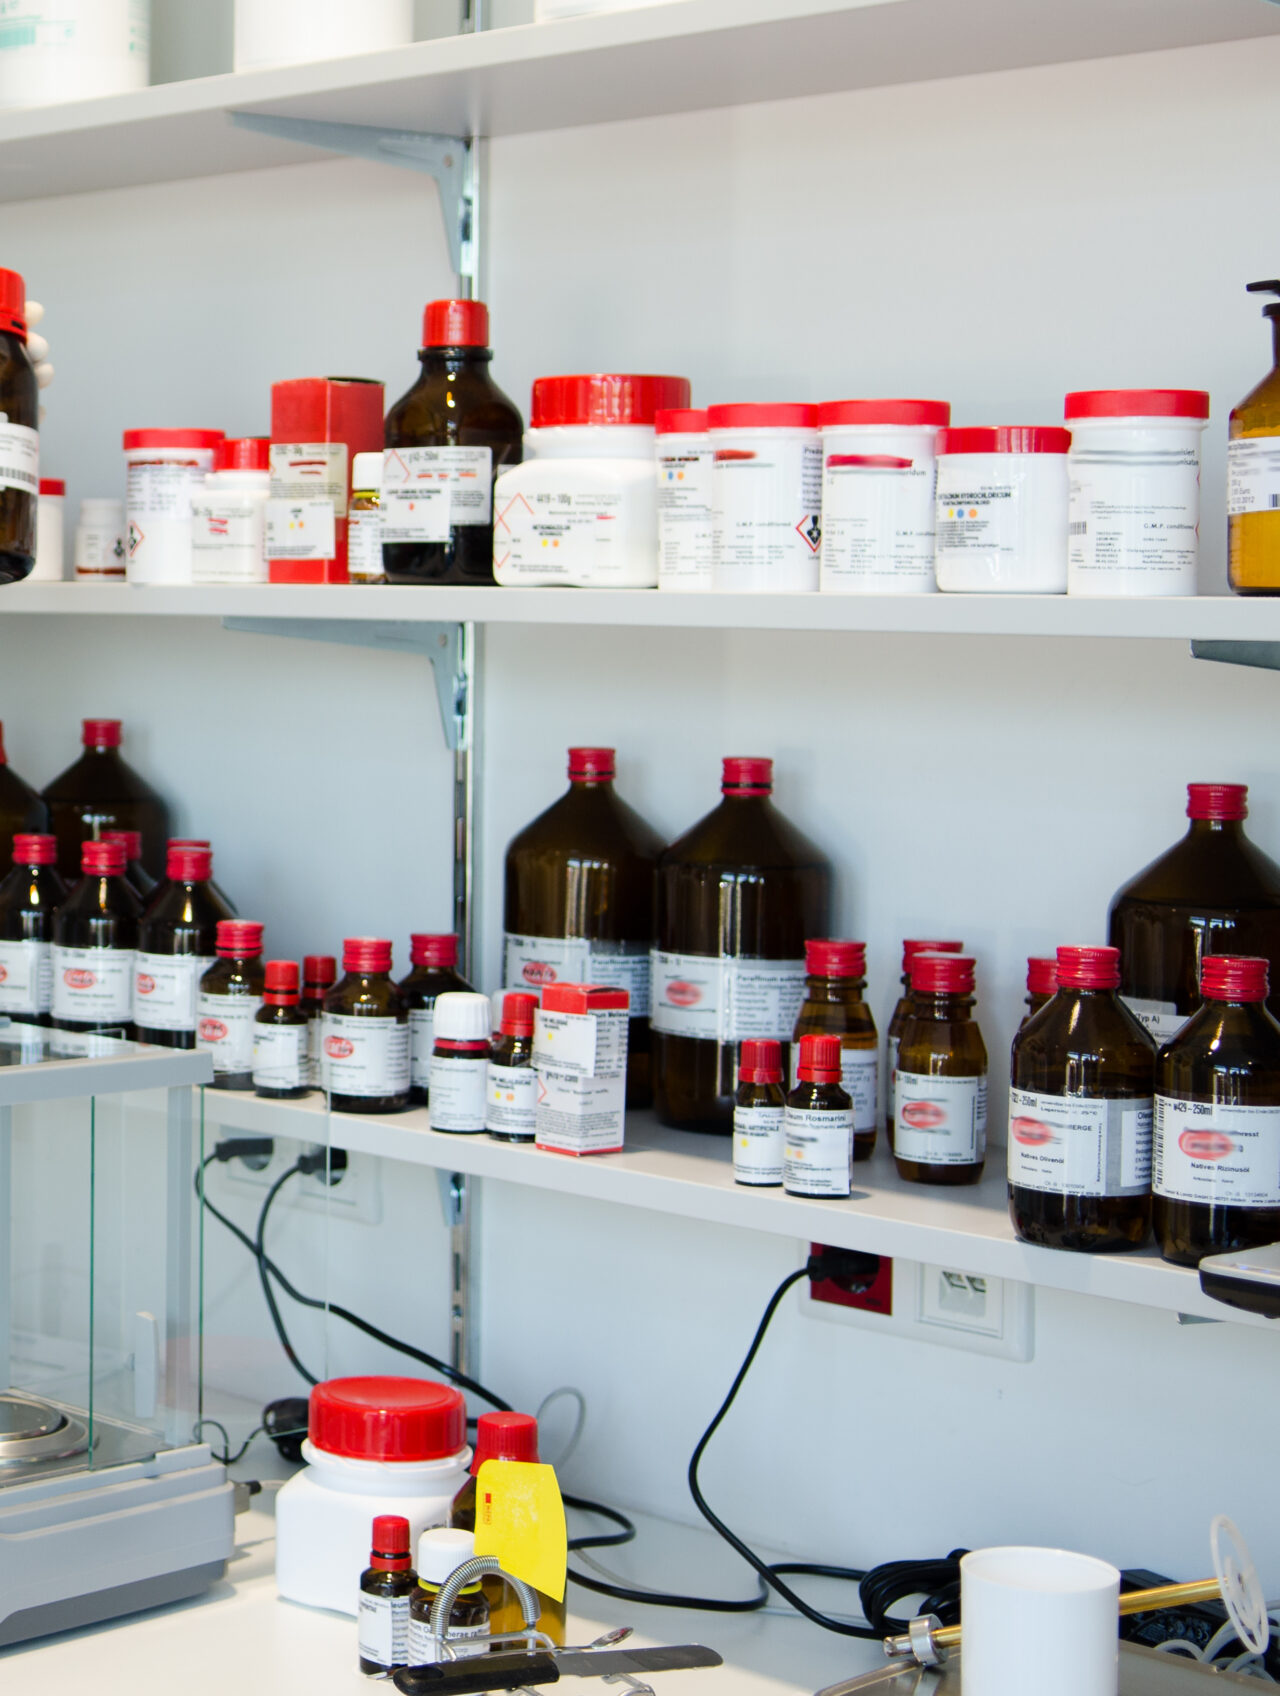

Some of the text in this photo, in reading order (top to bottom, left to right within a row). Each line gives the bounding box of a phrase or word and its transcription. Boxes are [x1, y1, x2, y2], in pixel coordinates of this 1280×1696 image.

[1193, 1103, 1213, 1116] 250ml
[806, 1113, 846, 1123] Rosmarini
[1217, 1164, 1250, 1174] Rizinusöl
